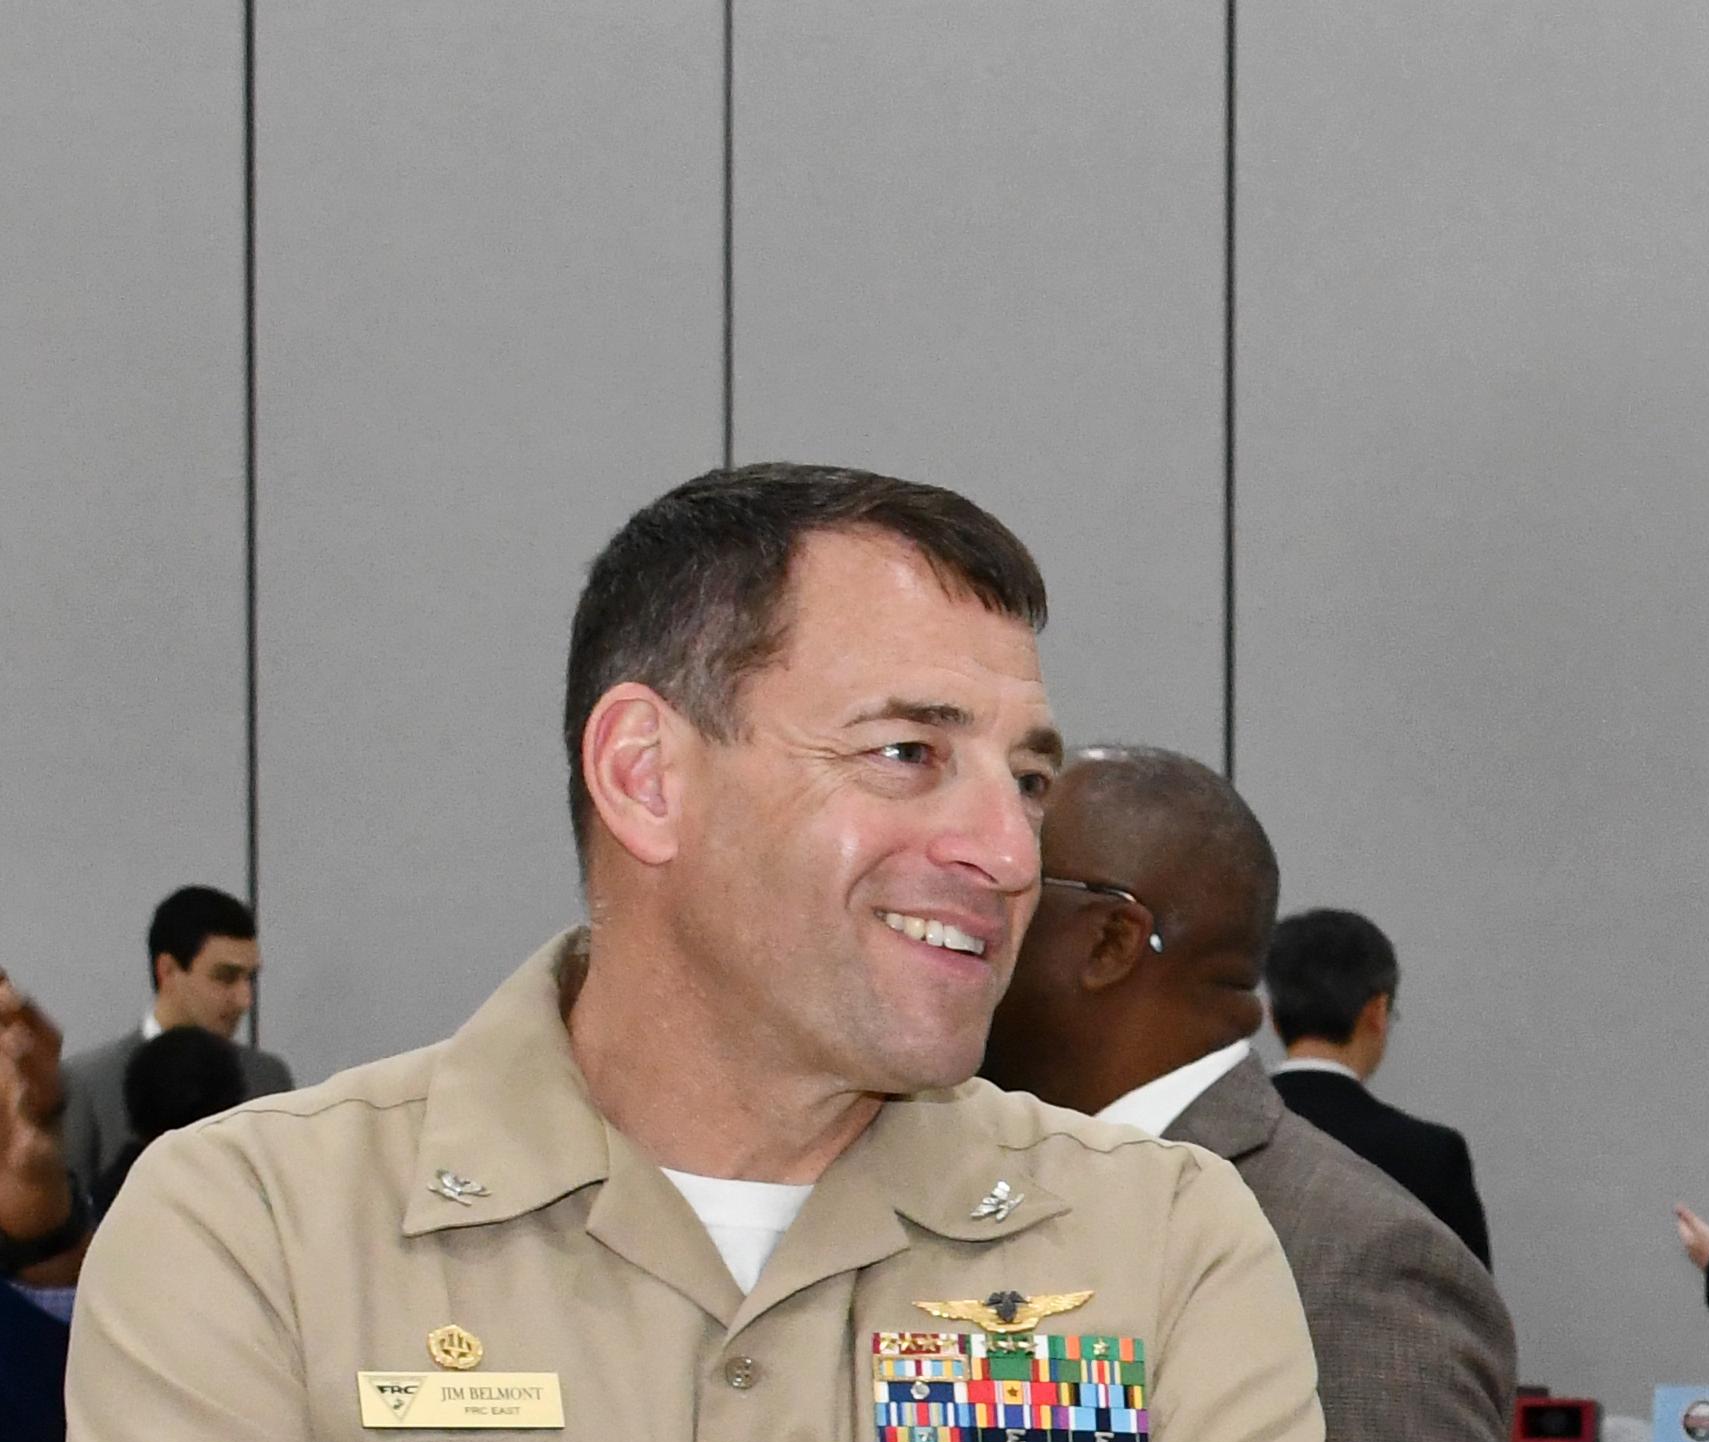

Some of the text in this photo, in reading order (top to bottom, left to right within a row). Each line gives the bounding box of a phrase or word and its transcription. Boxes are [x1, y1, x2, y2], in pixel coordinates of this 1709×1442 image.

[377, 1384, 419, 1395] FRC
[441, 1386, 544, 1402] JIM BELMONT
[464, 1406, 520, 1415] FRC EAST
